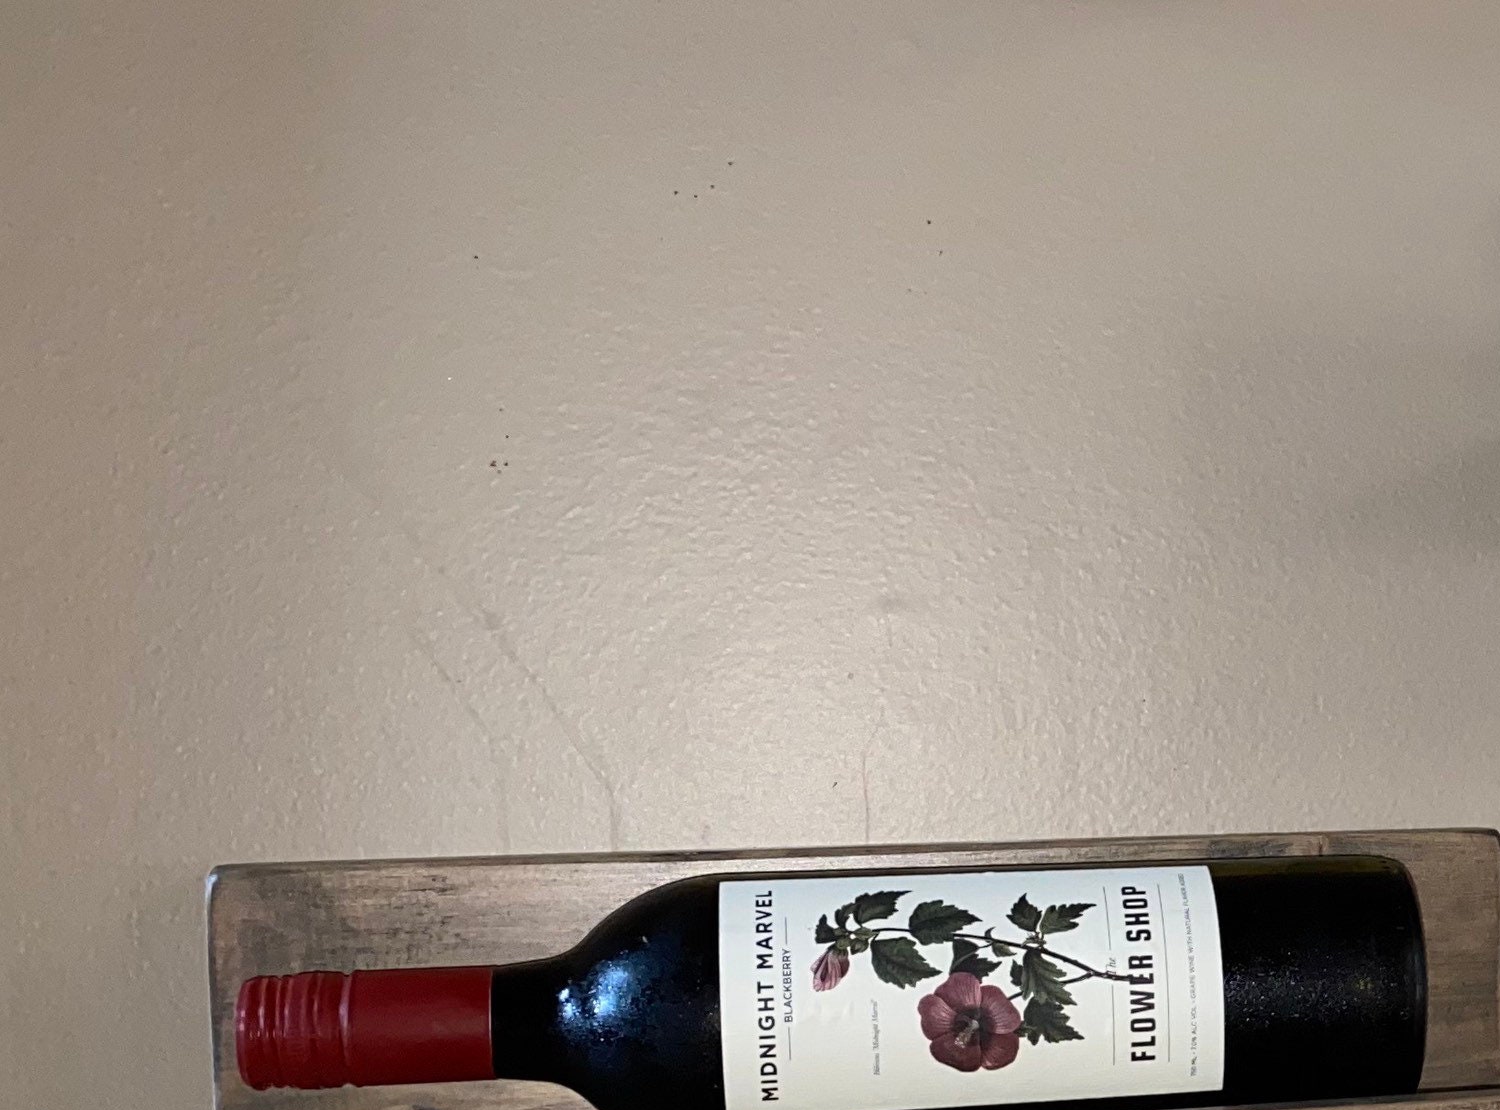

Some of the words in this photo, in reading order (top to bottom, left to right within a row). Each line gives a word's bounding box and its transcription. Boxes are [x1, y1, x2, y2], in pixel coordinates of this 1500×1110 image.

[755, 890, 774, 970] MARVEL
[1121, 886, 1152, 942] SHOP
[781, 948, 794, 1023] BLACKBERRY
[1128, 955, 1157, 1062] FLOWER
[757, 981, 779, 1102] MIDNIGHT
